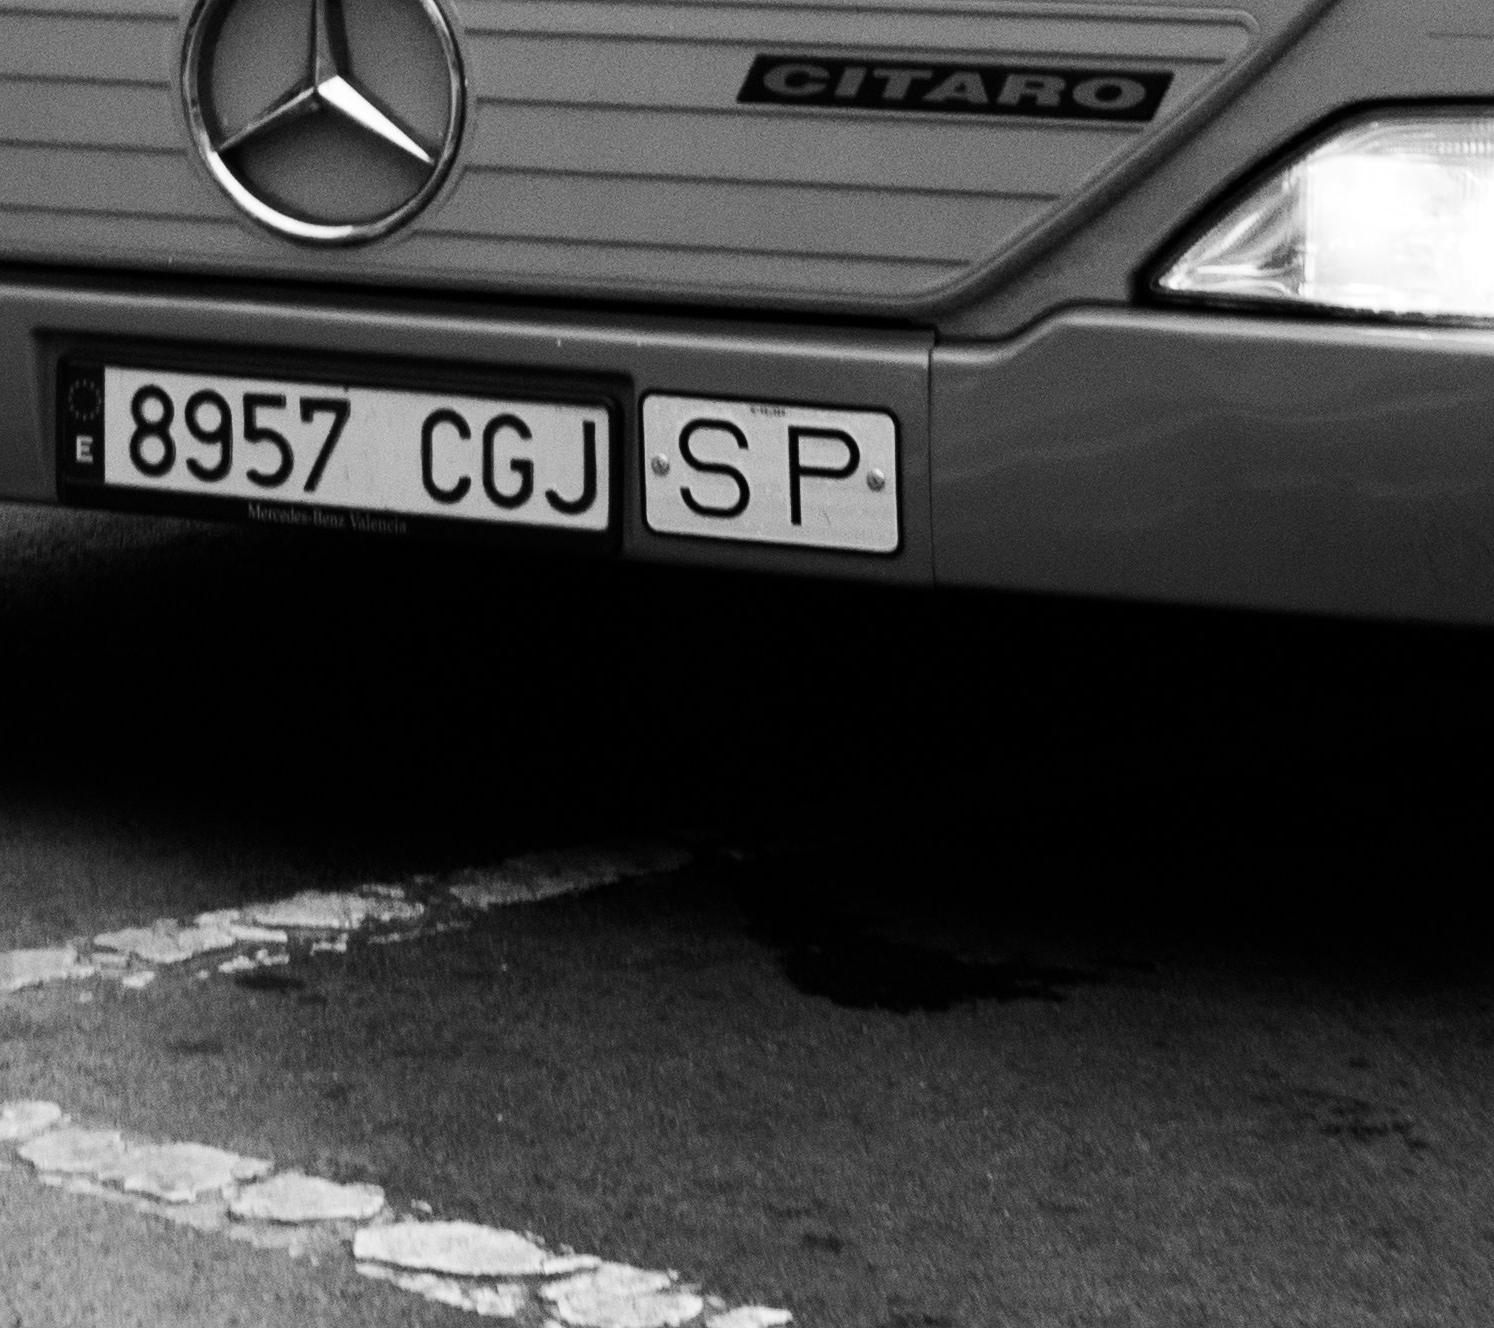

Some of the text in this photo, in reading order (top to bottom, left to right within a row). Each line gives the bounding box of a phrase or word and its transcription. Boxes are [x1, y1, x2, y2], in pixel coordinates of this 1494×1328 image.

[762, 62, 1147, 111] CITARO
[75, 434, 94, 463] E
[128, 384, 597, 516] 8957 CGJ
[247, 501, 407, 535] Mercedes-Benz Valencia
